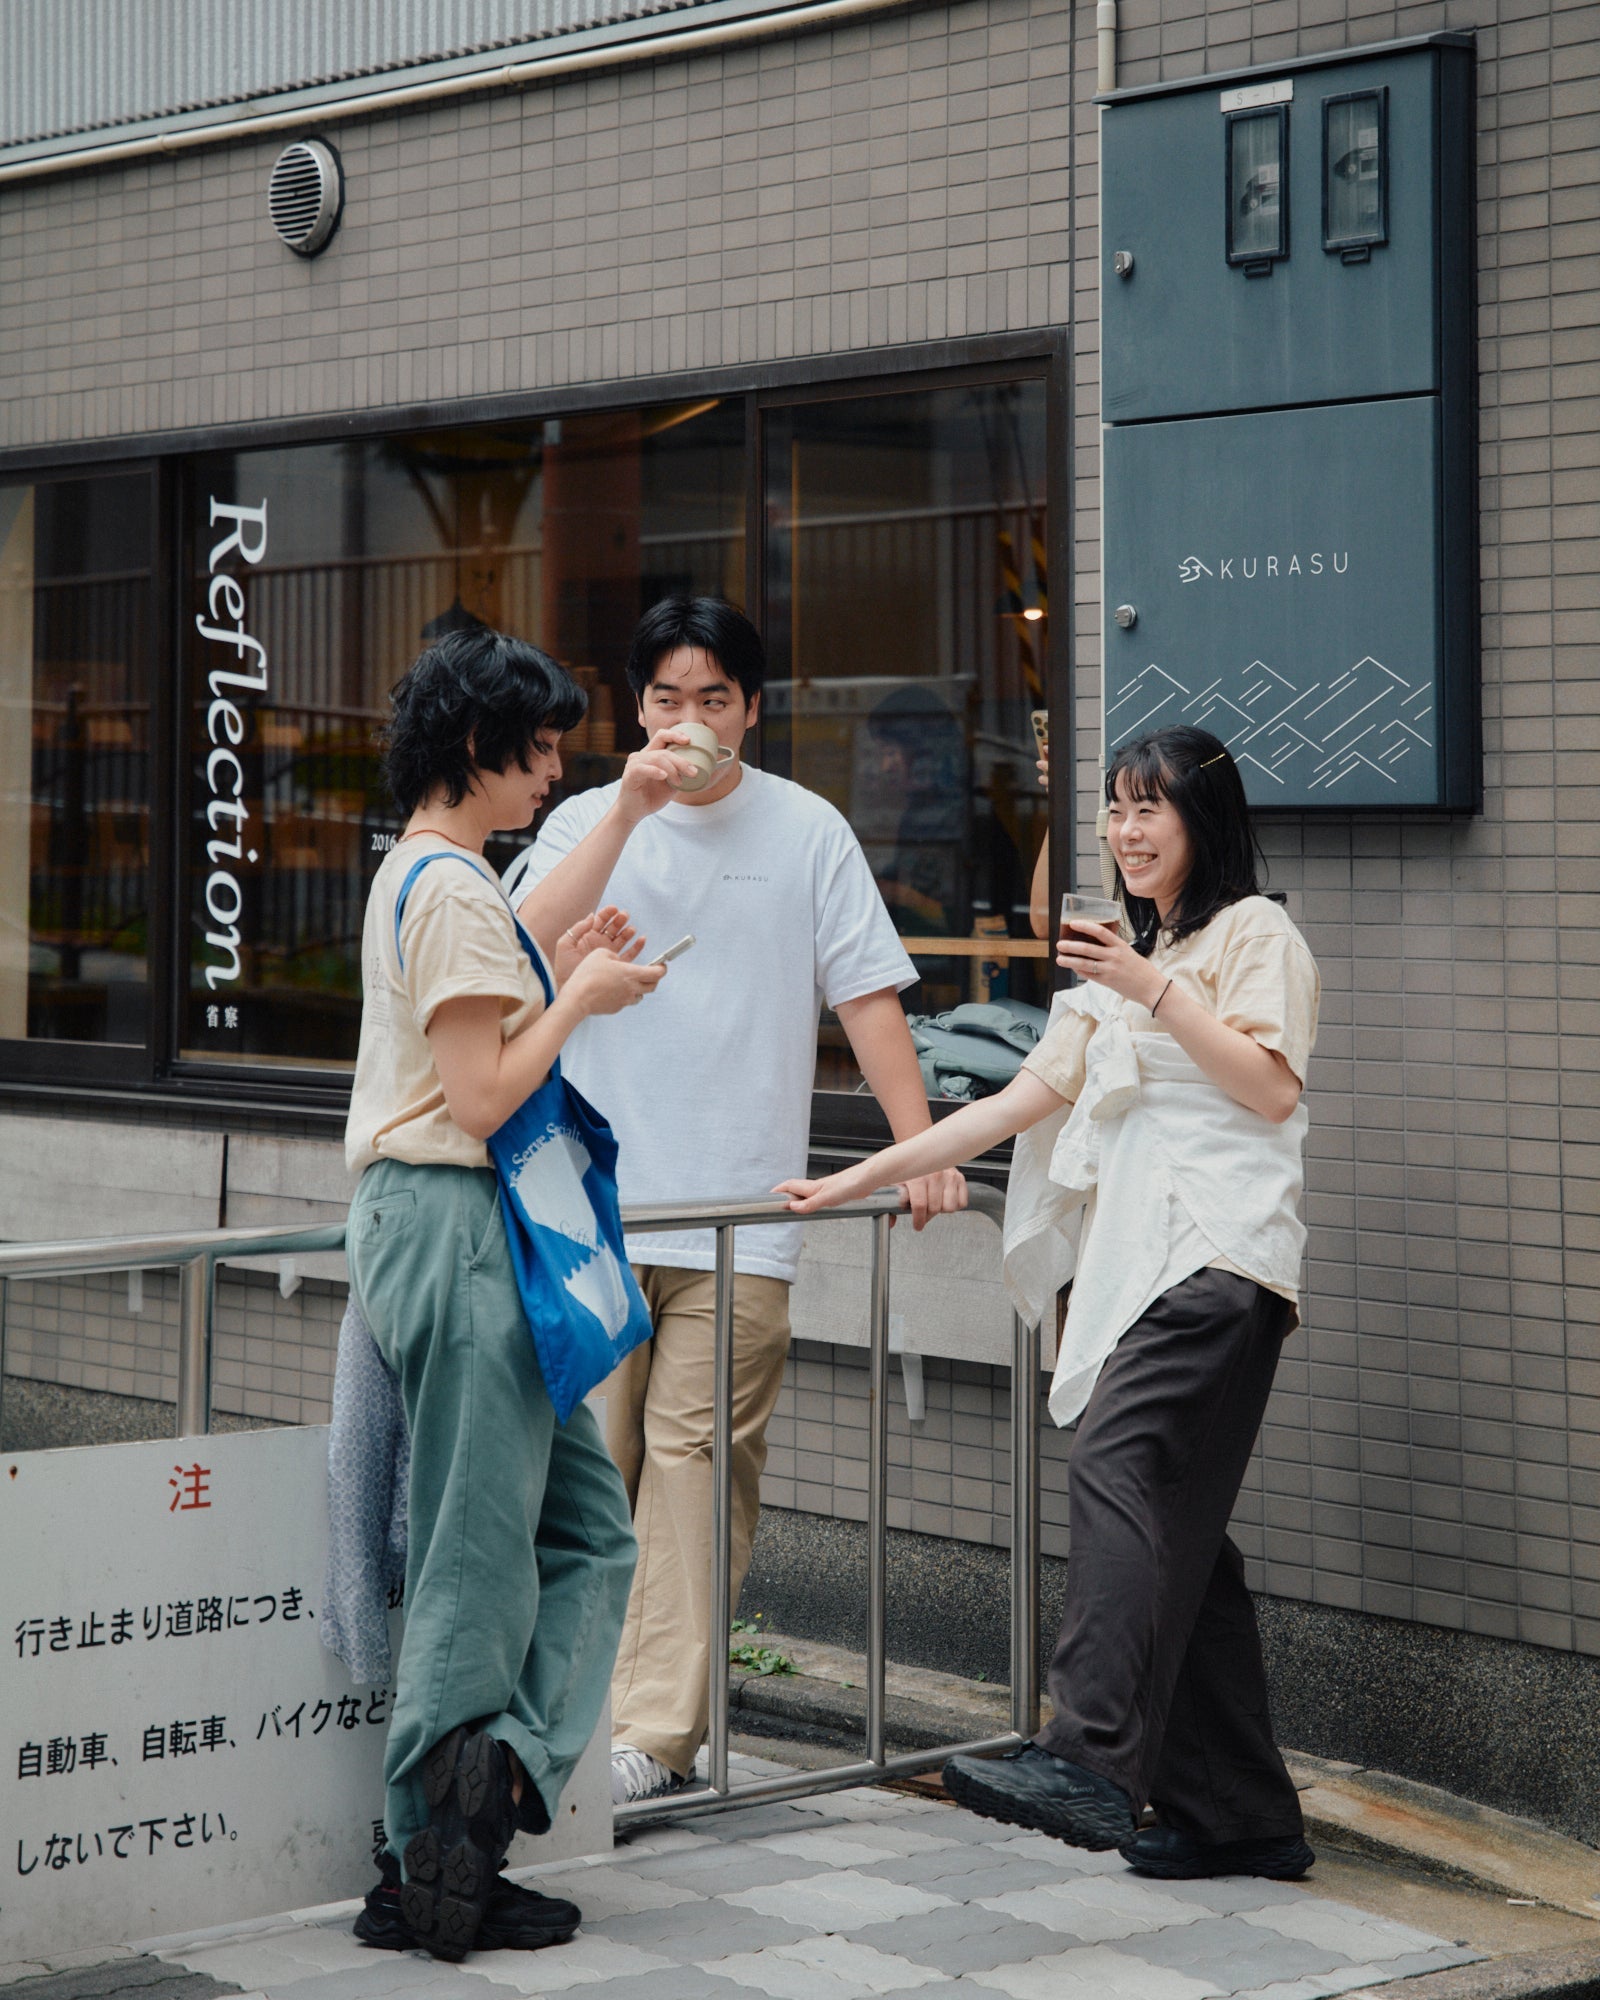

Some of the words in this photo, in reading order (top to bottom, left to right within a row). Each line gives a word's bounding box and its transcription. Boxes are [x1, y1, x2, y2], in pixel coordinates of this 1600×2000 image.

[1220, 551, 1348, 580] KURASU
[196, 495, 268, 990] Reflection
[371, 833, 397, 851] 2016
[168, 1463, 211, 1512] 注
[15, 1586, 315, 1658] 行き止まり道路につき、
[18, 1689, 398, 1780] 自動車、自転車、バイクなど
[17, 1812, 238, 1876] しないで下さい。
